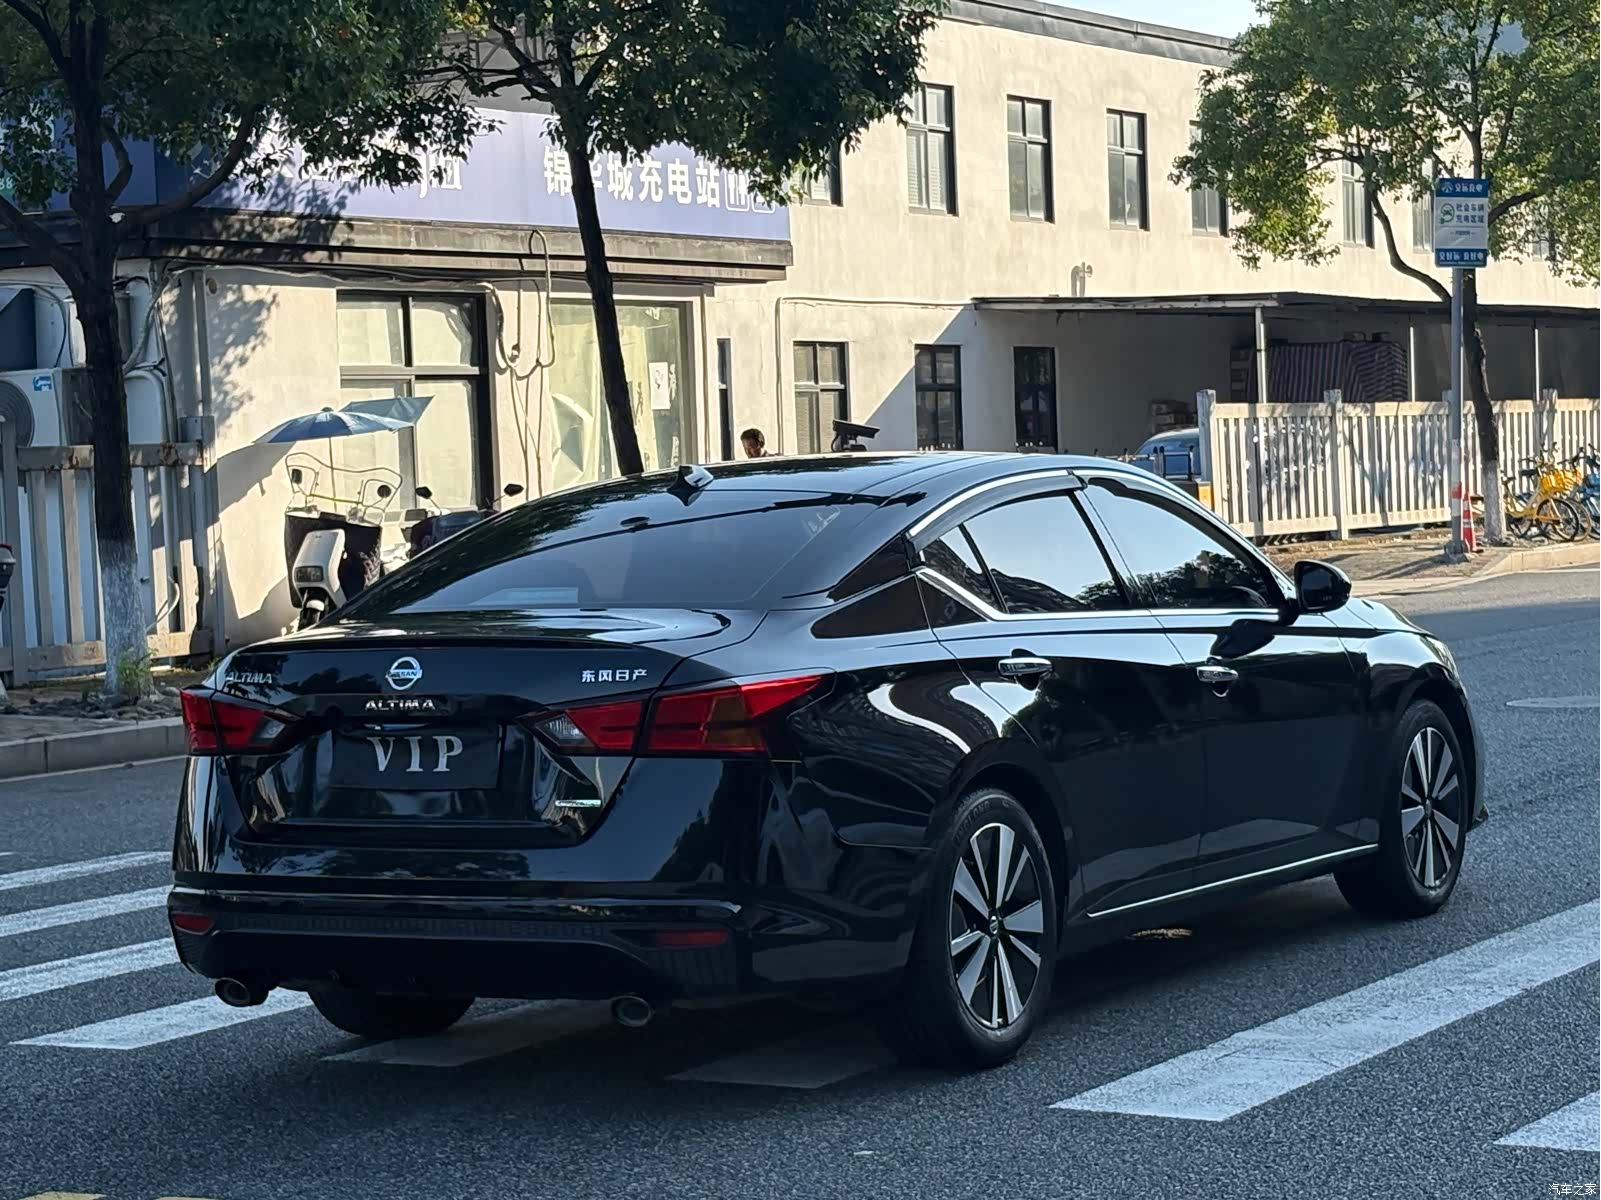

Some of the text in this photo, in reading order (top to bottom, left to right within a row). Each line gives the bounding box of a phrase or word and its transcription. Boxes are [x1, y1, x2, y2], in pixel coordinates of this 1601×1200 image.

[225, 670, 273, 684] ALTIMA
[581, 668, 648, 683] 东风日产
[364, 699, 436, 711] ALTIMA
[366, 735, 464, 772] VIP
